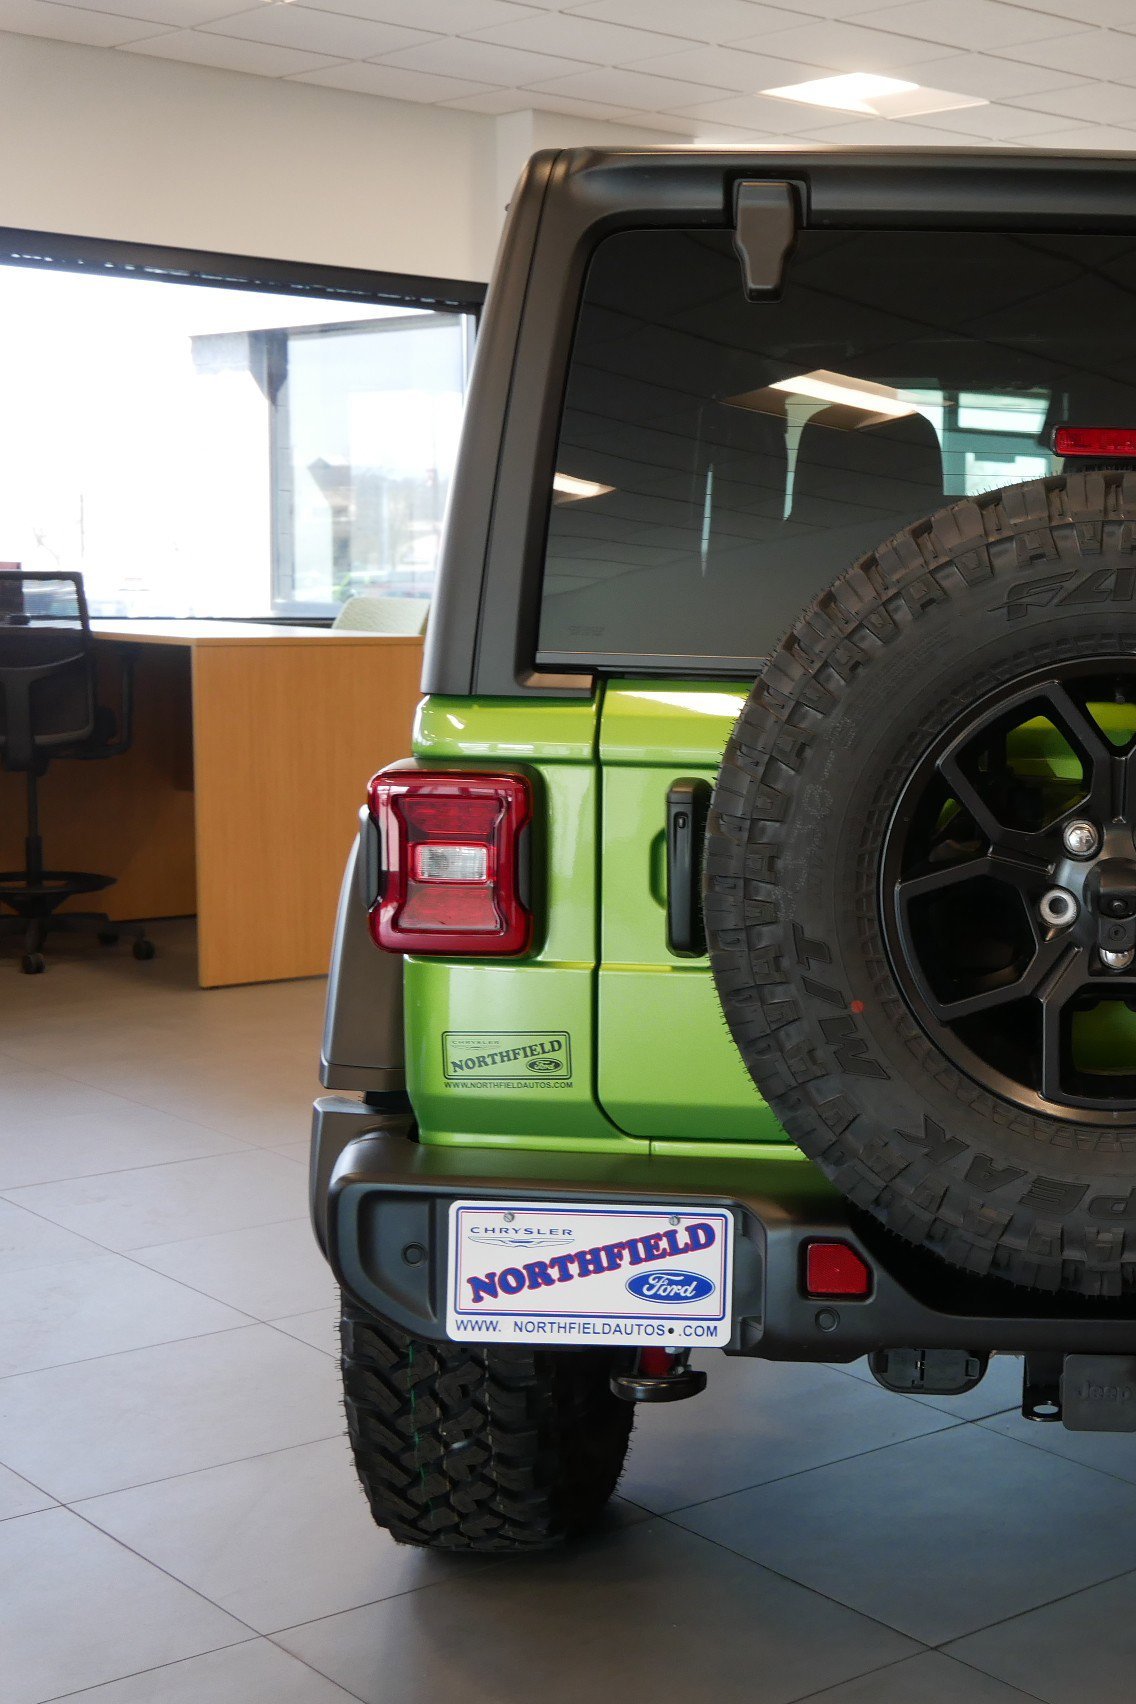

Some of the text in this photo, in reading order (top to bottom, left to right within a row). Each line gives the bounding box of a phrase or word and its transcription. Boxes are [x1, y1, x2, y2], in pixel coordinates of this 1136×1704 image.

[451, 1040, 563, 1073] NORTHFIELD
[444, 1081, 574, 1089] WWW.NORTHFIELDAUTOS.COM
[470, 1225, 573, 1236] CHRYSLER
[466, 1222, 717, 1304] NORTHFIELD
[642, 1273, 697, 1298] Ford
